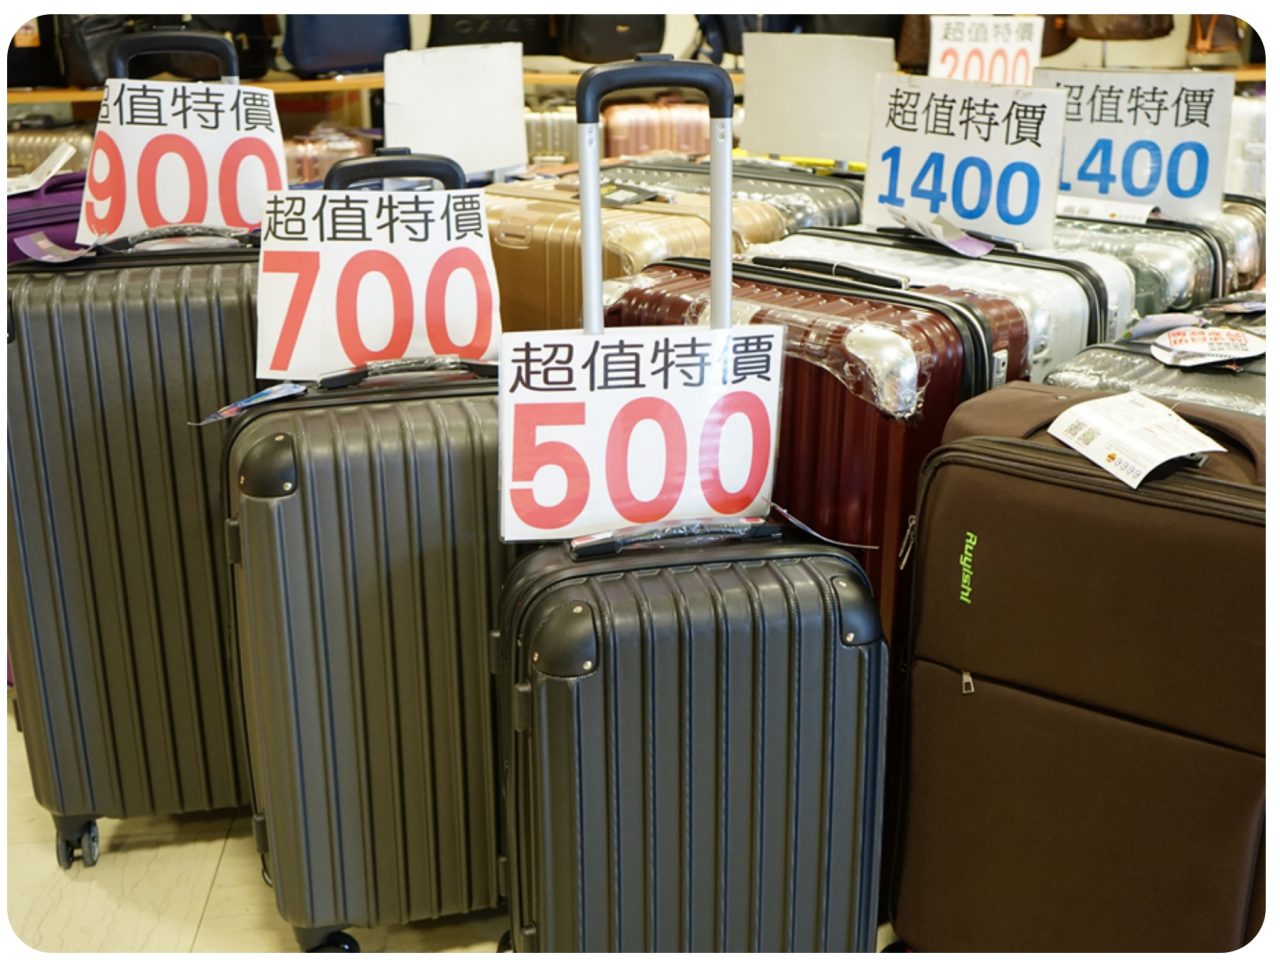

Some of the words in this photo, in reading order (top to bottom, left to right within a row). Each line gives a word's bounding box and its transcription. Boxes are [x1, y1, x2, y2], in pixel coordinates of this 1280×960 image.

[940, 47, 1030, 85] 2000
[885, 88, 1048, 148] 超值特價
[85, 131, 283, 236] 900
[263, 194, 483, 243] 超值特價
[878, 146, 1040, 225] 1400
[263, 247, 492, 371] 700
[510, 335, 774, 393] 超值特價
[510, 391, 771, 530] 500
[960, 531, 978, 605] Ruyishi
